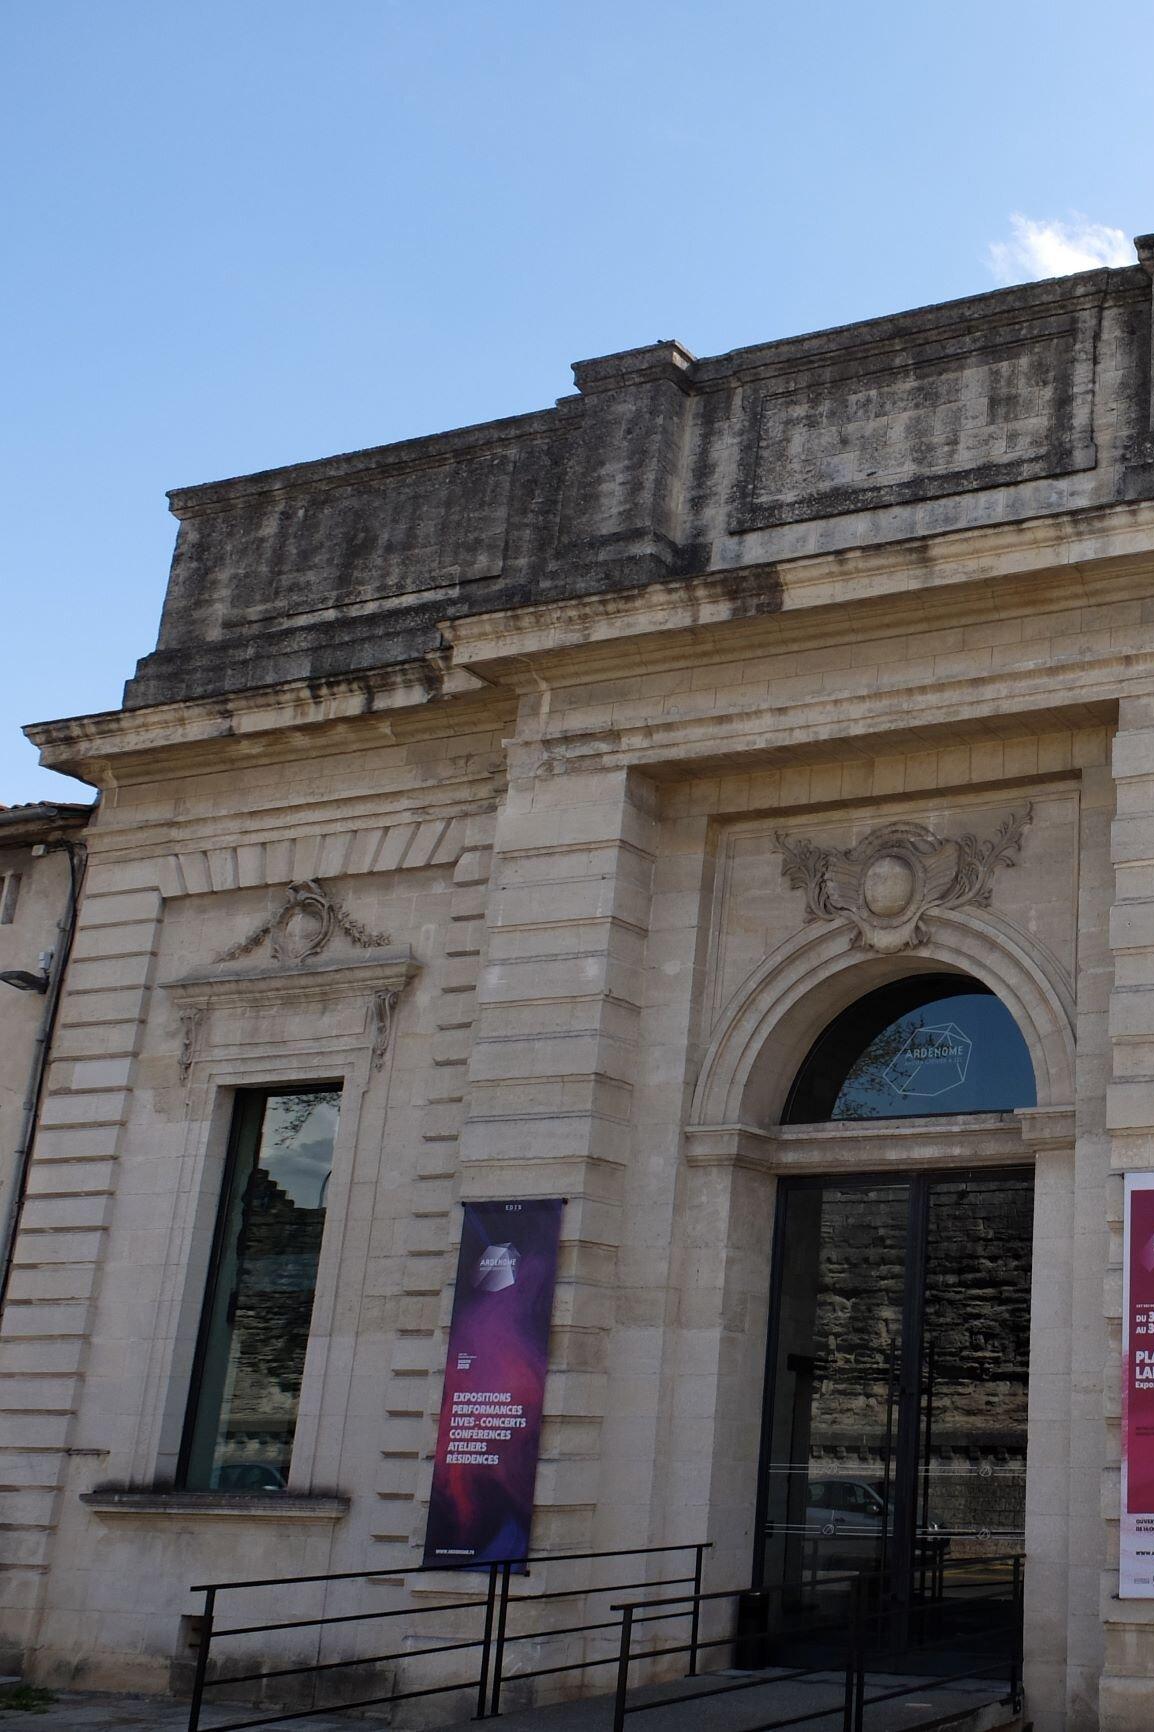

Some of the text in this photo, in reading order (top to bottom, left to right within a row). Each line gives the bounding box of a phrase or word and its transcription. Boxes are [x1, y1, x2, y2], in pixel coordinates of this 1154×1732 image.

[906, 1045, 964, 1059] ARDENOME
[1136, 1326, 1147, 1334] AU
[1147, 1323, 1154, 1334] 3
[453, 1392, 512, 1402] EXPOSITIONS
[451, 1404, 523, 1415] PERFORMANCES
[450, 1417, 475, 1427] LIVES
[480, 1417, 527, 1428] CONCERTS
[449, 1428, 512, 1440] CONFÉRENCES
[447, 1441, 487, 1452] ATELIERS
[446, 1452, 499, 1465] RÉSIDENCES
